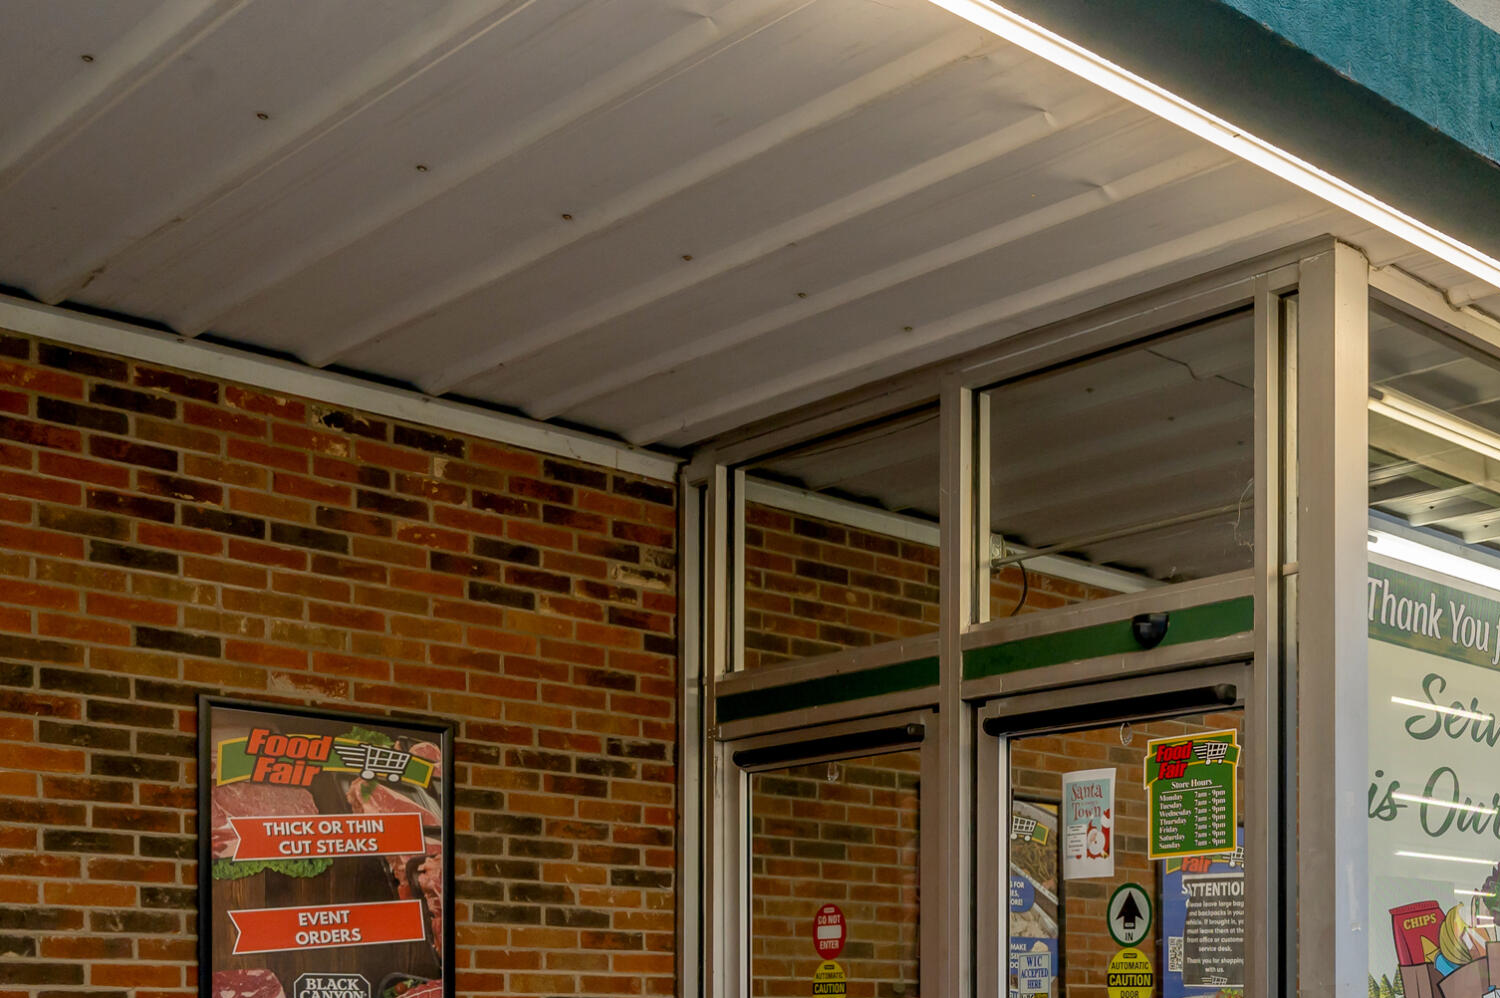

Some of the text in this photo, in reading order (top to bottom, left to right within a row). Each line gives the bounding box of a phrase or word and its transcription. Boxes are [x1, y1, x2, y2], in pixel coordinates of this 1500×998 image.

[1368, 577, 1443, 640] Thank
[1450, 600, 1489, 652] You
[247, 728, 333, 761] Food
[1156, 741, 1193, 763] Food
[253, 757, 321, 786] Fair
[1158, 761, 1188, 780] Fair
[1071, 783, 1103, 801] Santa
[1171, 778, 1212, 790] Store Hours
[1368, 769, 1408, 822] is
[1072, 802, 1101, 821] Town
[1160, 809, 1192, 818] Wednesday
[263, 819, 384, 836] THICK OR THIN
[1160, 818, 1187, 826] Thursday
[279, 838, 378, 855] CUT STEAKS
[1182, 856, 1212, 872] Fair
[1186, 881, 1244, 896] ATTENTIO
[298, 910, 350, 926] EVENT
[827, 914, 841, 924] NOT
[1403, 913, 1437, 930] CHIPS
[295, 928, 362, 945] ORDERS
[1125, 932, 1133, 941] IN
[819, 940, 839, 950] ENTER
[1026, 956, 1043, 967] WIC
[1111, 961, 1149, 970] AUTOMATIC
[1021, 968, 1048, 979] ACCEPTED
[1109, 974, 1151, 986] CAUTION
[305, 978, 360, 991] BLACK
[814, 983, 845, 994] CAUTION
